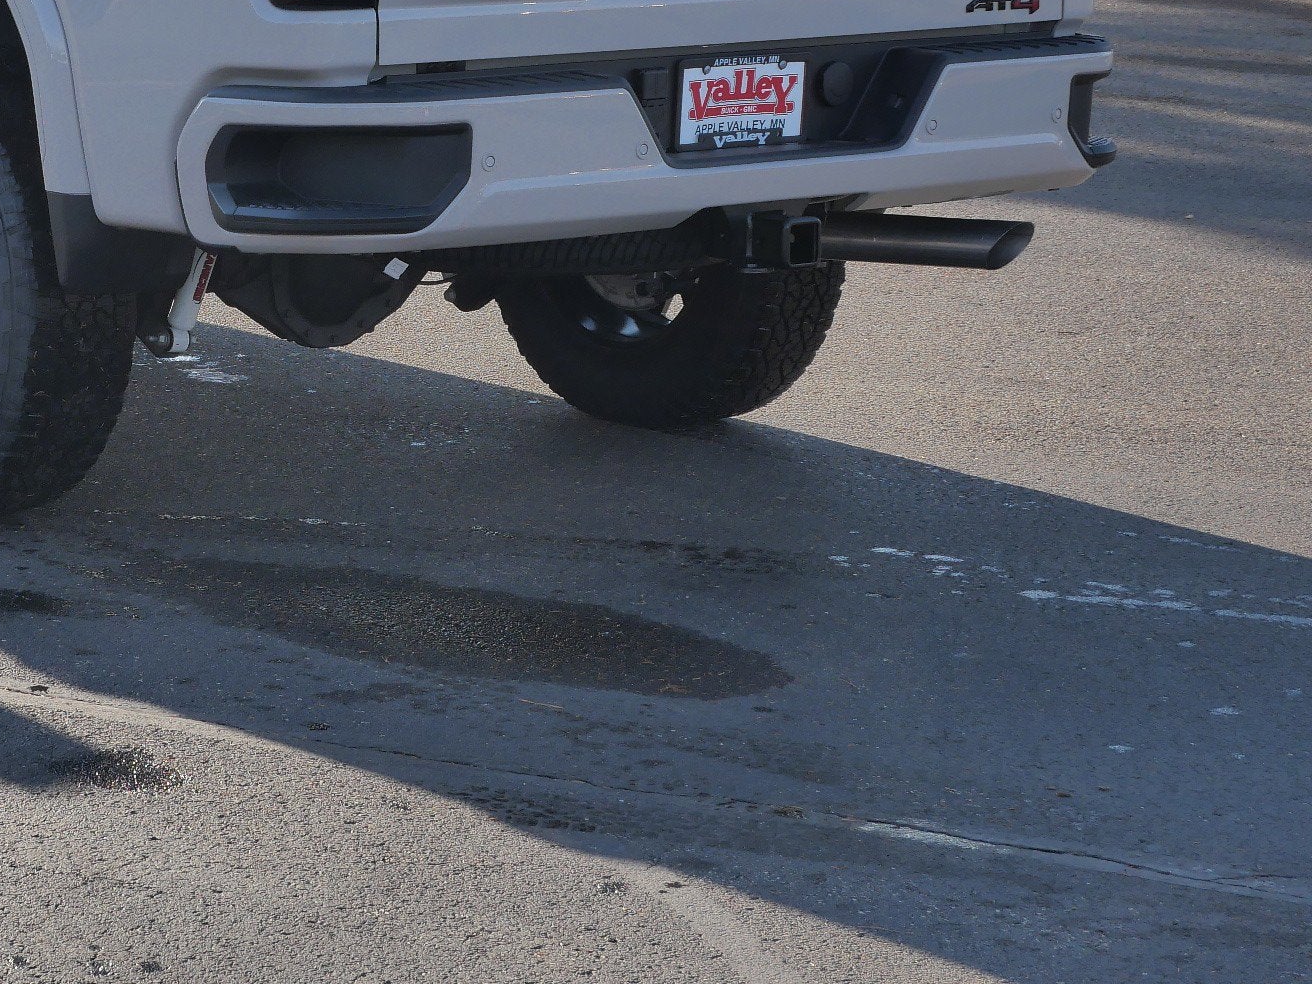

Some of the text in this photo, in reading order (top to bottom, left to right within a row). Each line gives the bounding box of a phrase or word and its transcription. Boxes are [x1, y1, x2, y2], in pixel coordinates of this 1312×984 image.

[714, 58, 738, 67] APPLE
[769, 55, 780, 63] MN
[695, 122, 725, 135] APPLE
[770, 118, 786, 128] MN
